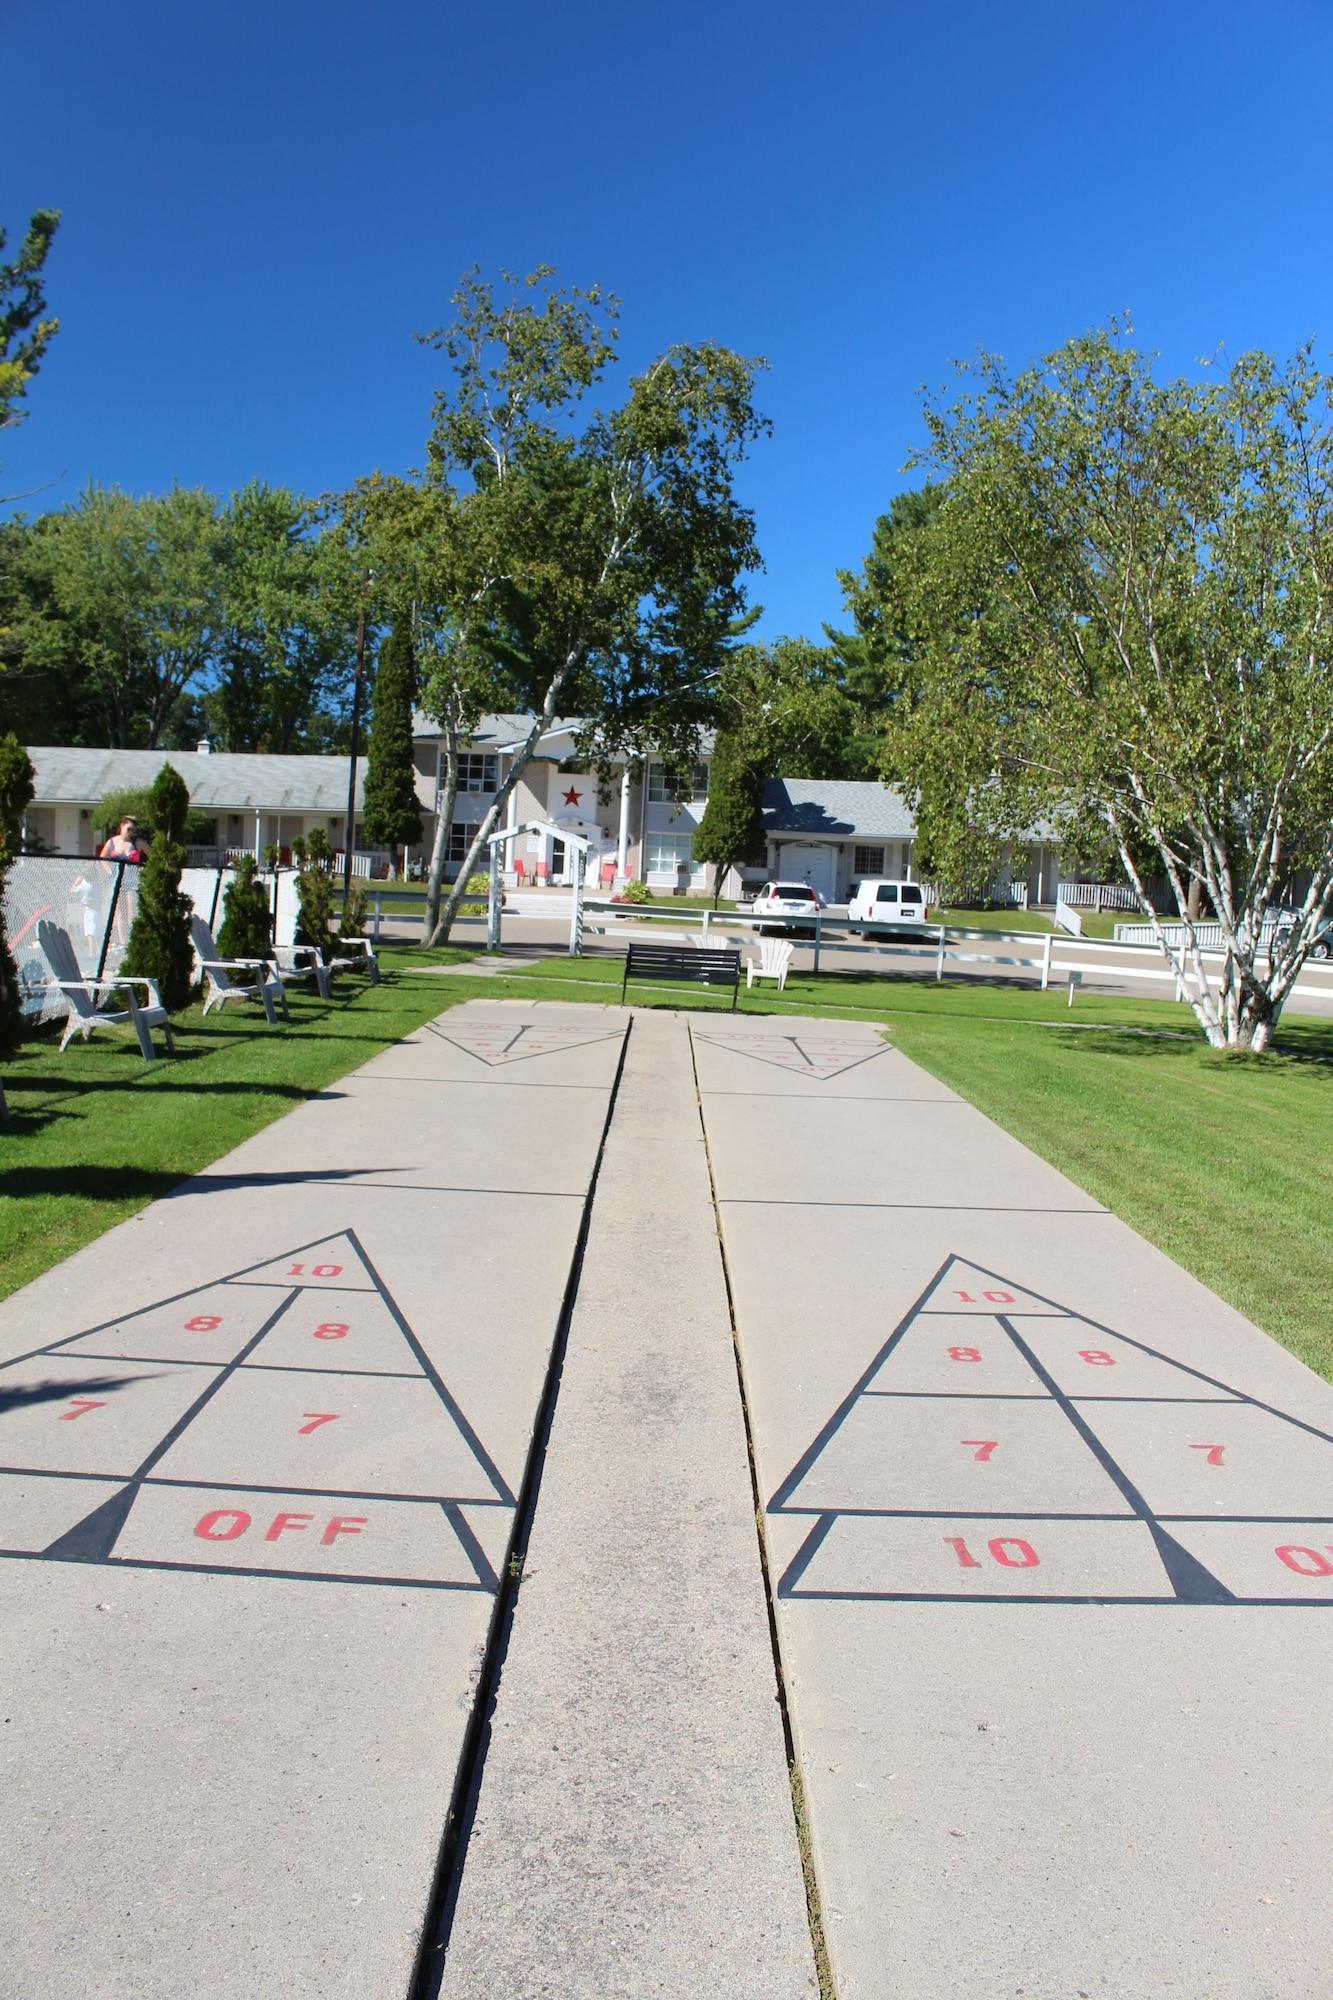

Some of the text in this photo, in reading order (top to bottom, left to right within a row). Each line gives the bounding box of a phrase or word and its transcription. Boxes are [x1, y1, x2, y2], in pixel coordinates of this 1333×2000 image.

[286, 1263, 343, 1278] 10
[952, 1290, 1016, 1305] 10
[184, 1315, 223, 1332] 8
[313, 1323, 350, 1341] 8
[947, 1346, 982, 1363] 8
[1078, 1350, 1116, 1366] 8
[58, 1400, 108, 1421] 7
[297, 1413, 340, 1435] 7
[960, 1439, 1000, 1462] 7
[1188, 1444, 1226, 1466] 7
[193, 1509, 369, 1546] OFF
[942, 1536, 1041, 1569] 10
[1274, 1545, 1333, 1577] O
